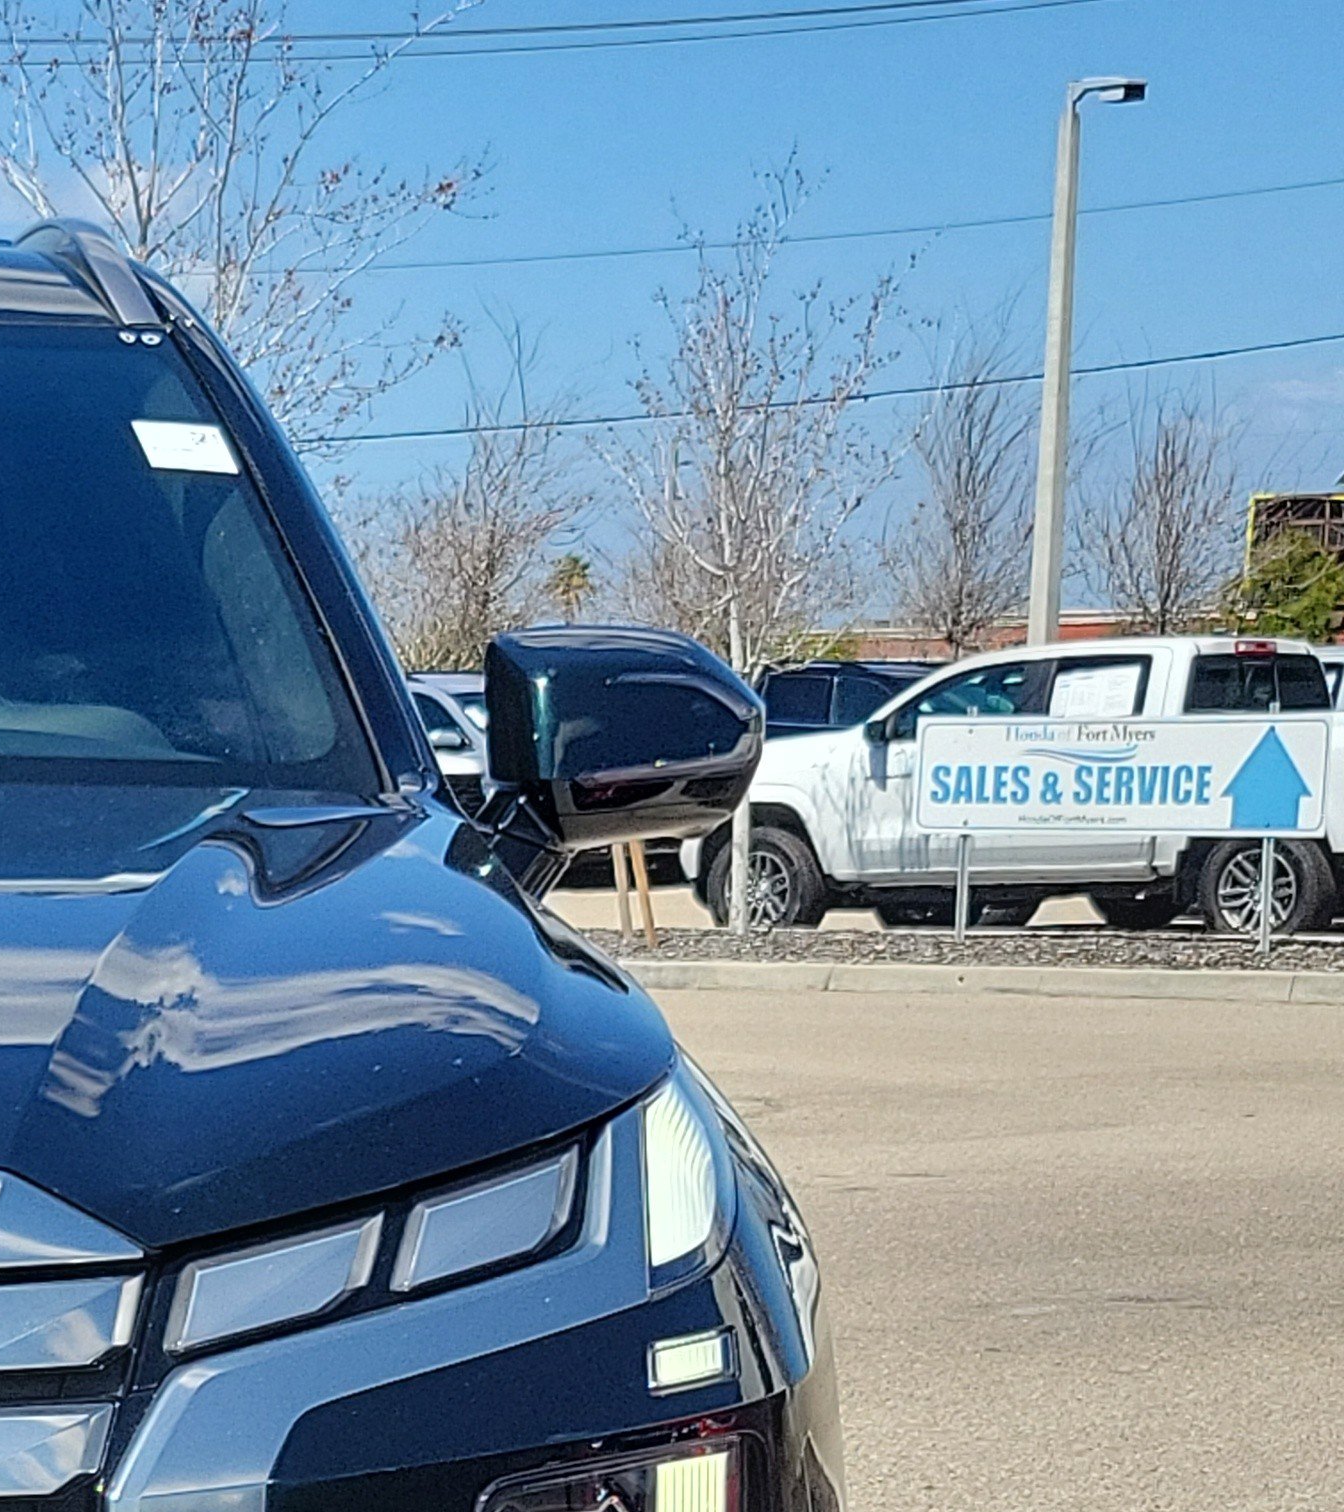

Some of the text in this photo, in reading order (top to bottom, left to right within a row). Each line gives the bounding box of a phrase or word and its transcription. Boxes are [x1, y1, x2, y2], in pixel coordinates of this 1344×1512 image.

[1005, 725, 1055, 742] Honda
[1076, 725, 1108, 742] Fort
[1110, 724, 1156, 746] Myers
[930, 765, 1212, 806] SALES & SERVICE
